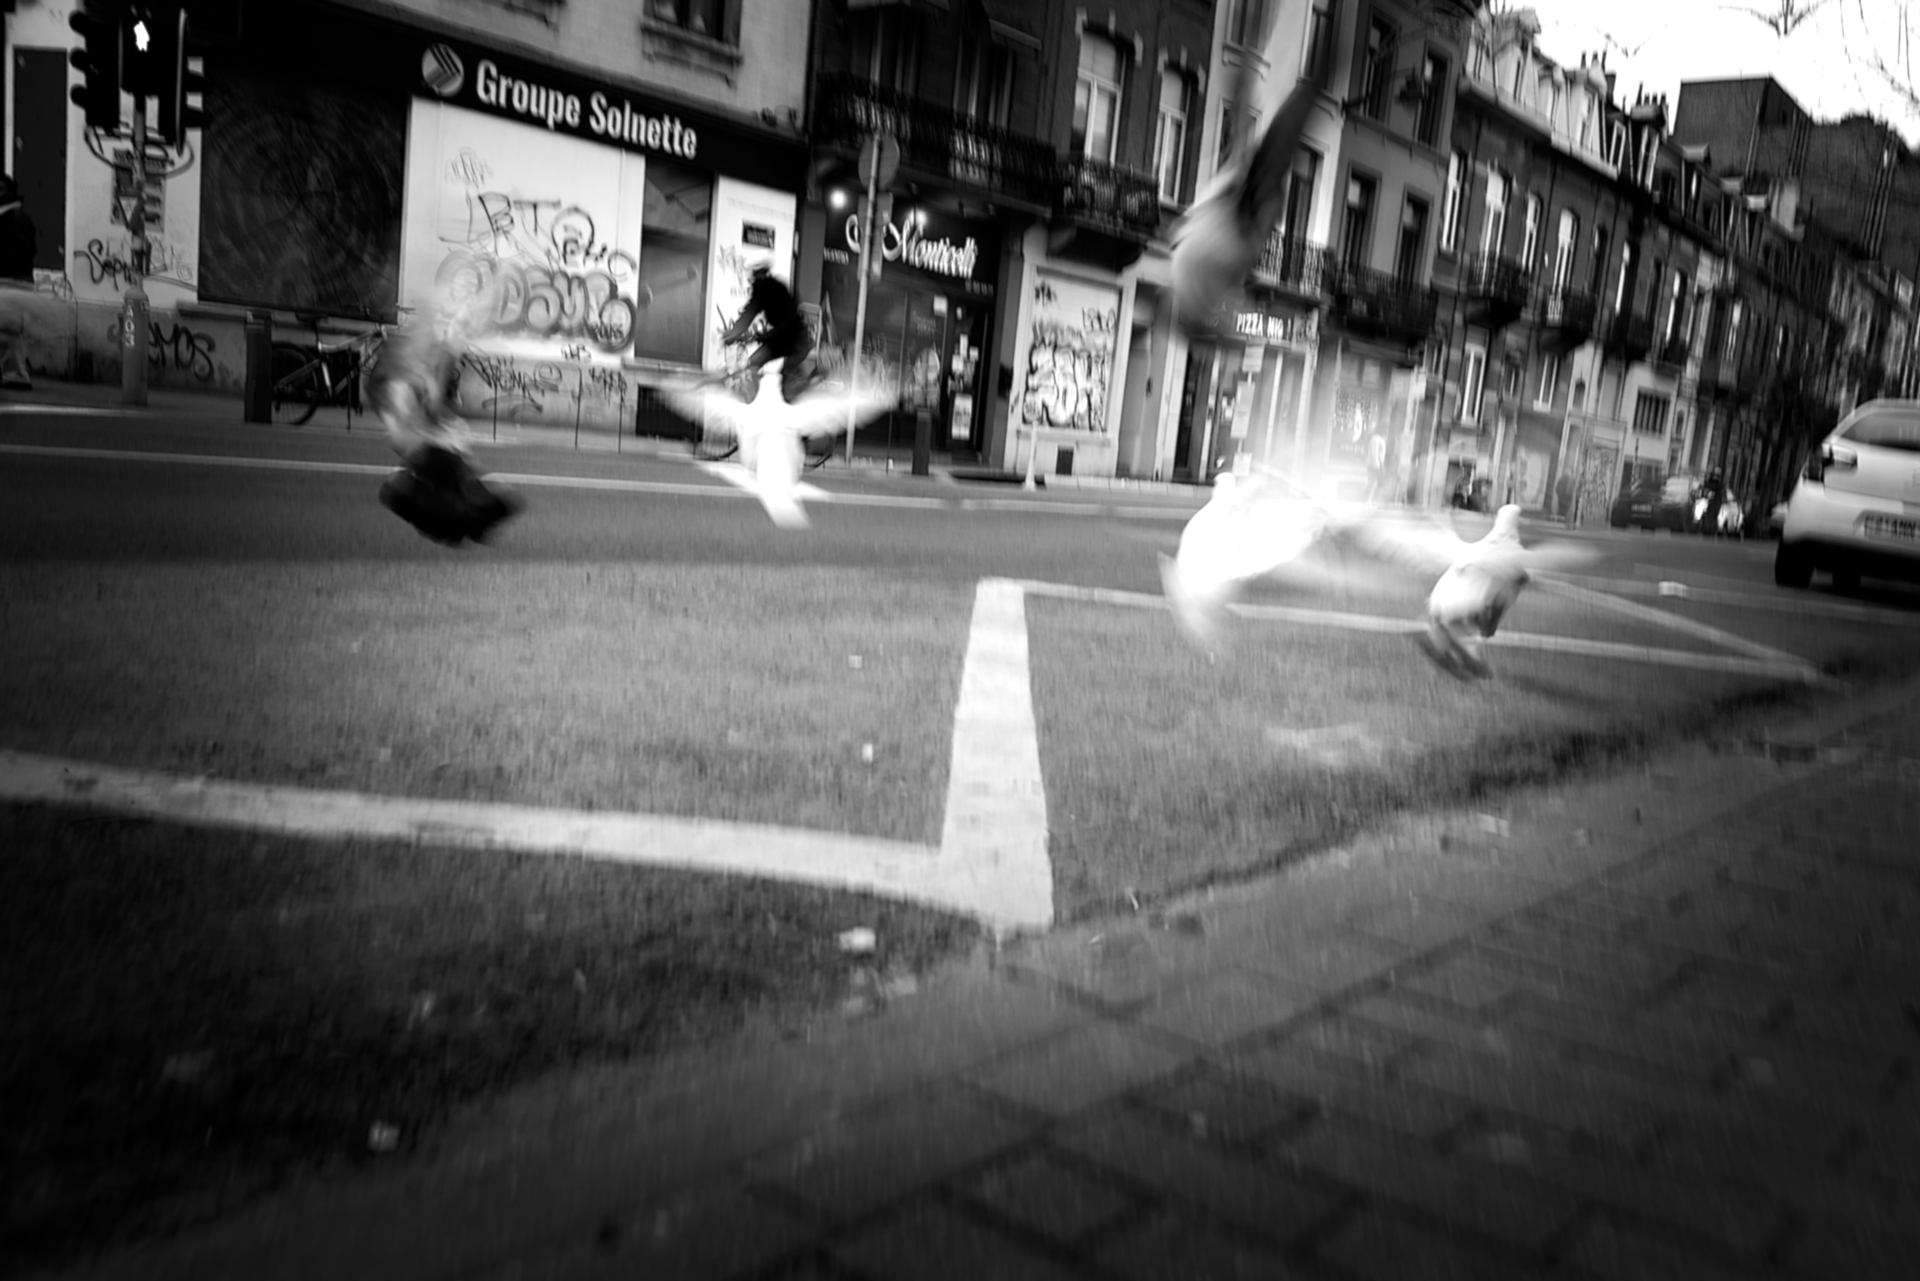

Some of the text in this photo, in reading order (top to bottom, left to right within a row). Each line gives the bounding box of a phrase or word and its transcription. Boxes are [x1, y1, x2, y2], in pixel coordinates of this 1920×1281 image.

[476, 59, 698, 160] Groupe Solnette
[1236, 312, 1263, 336] PIZZA
